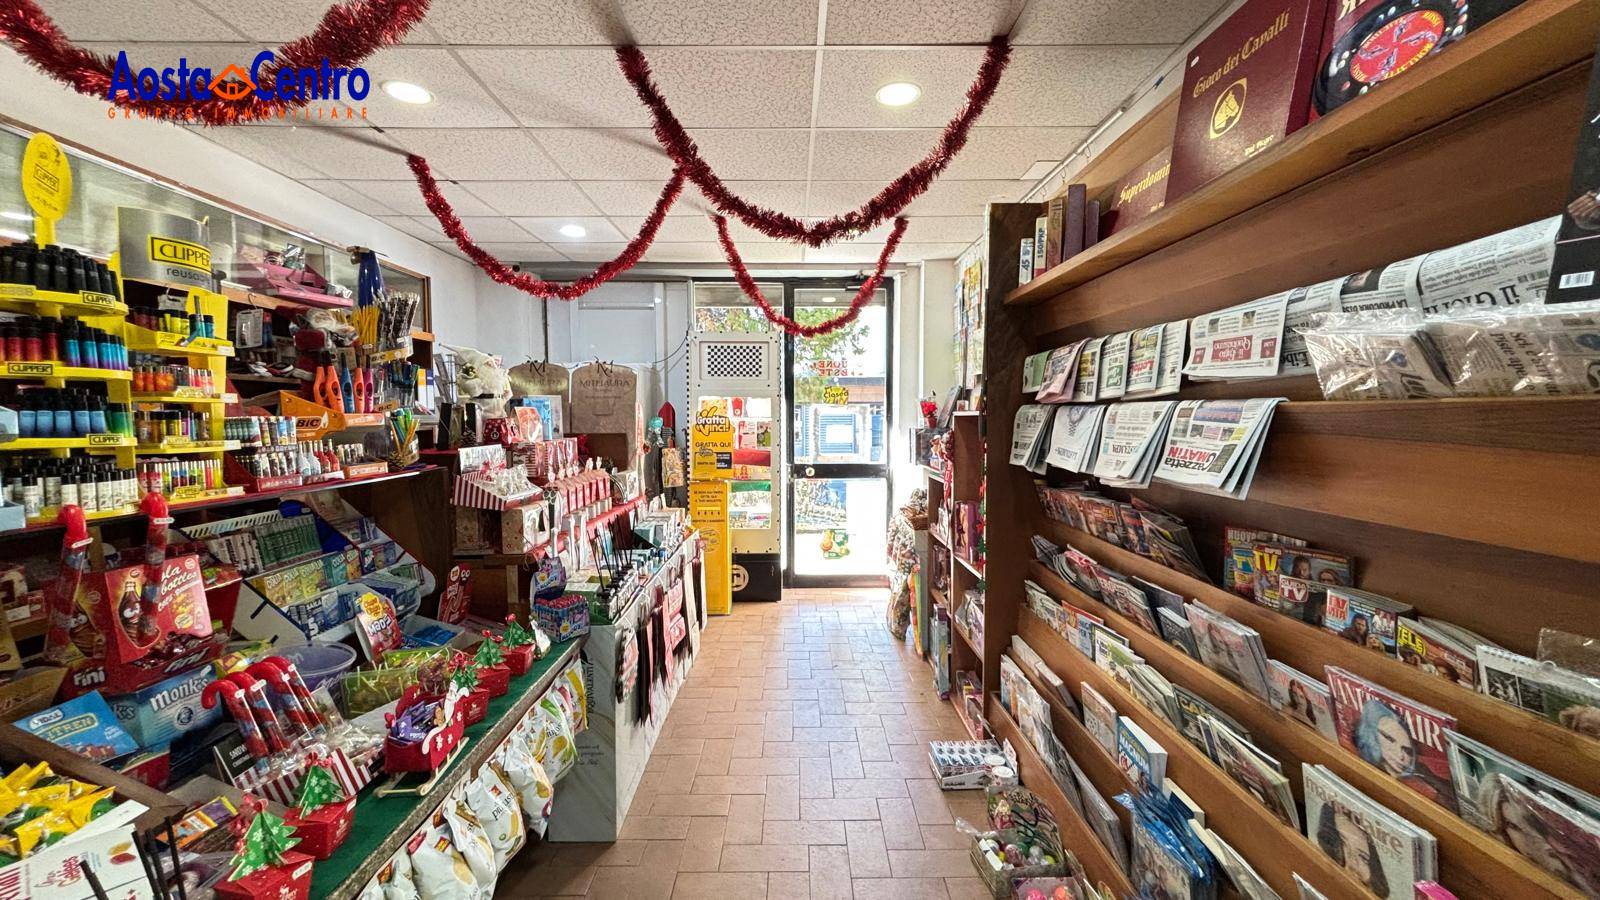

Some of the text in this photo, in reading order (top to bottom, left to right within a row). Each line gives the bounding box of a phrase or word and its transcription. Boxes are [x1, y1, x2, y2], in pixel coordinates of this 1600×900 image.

[1241, 8, 1291, 60] Cavalli
[296, 419, 321, 428] BIC
[696, 416, 725, 425] Gratta
[1254, 551, 1278, 571] TV
[1282, 583, 1308, 601] TV
[73, 667, 105, 686] Fini
